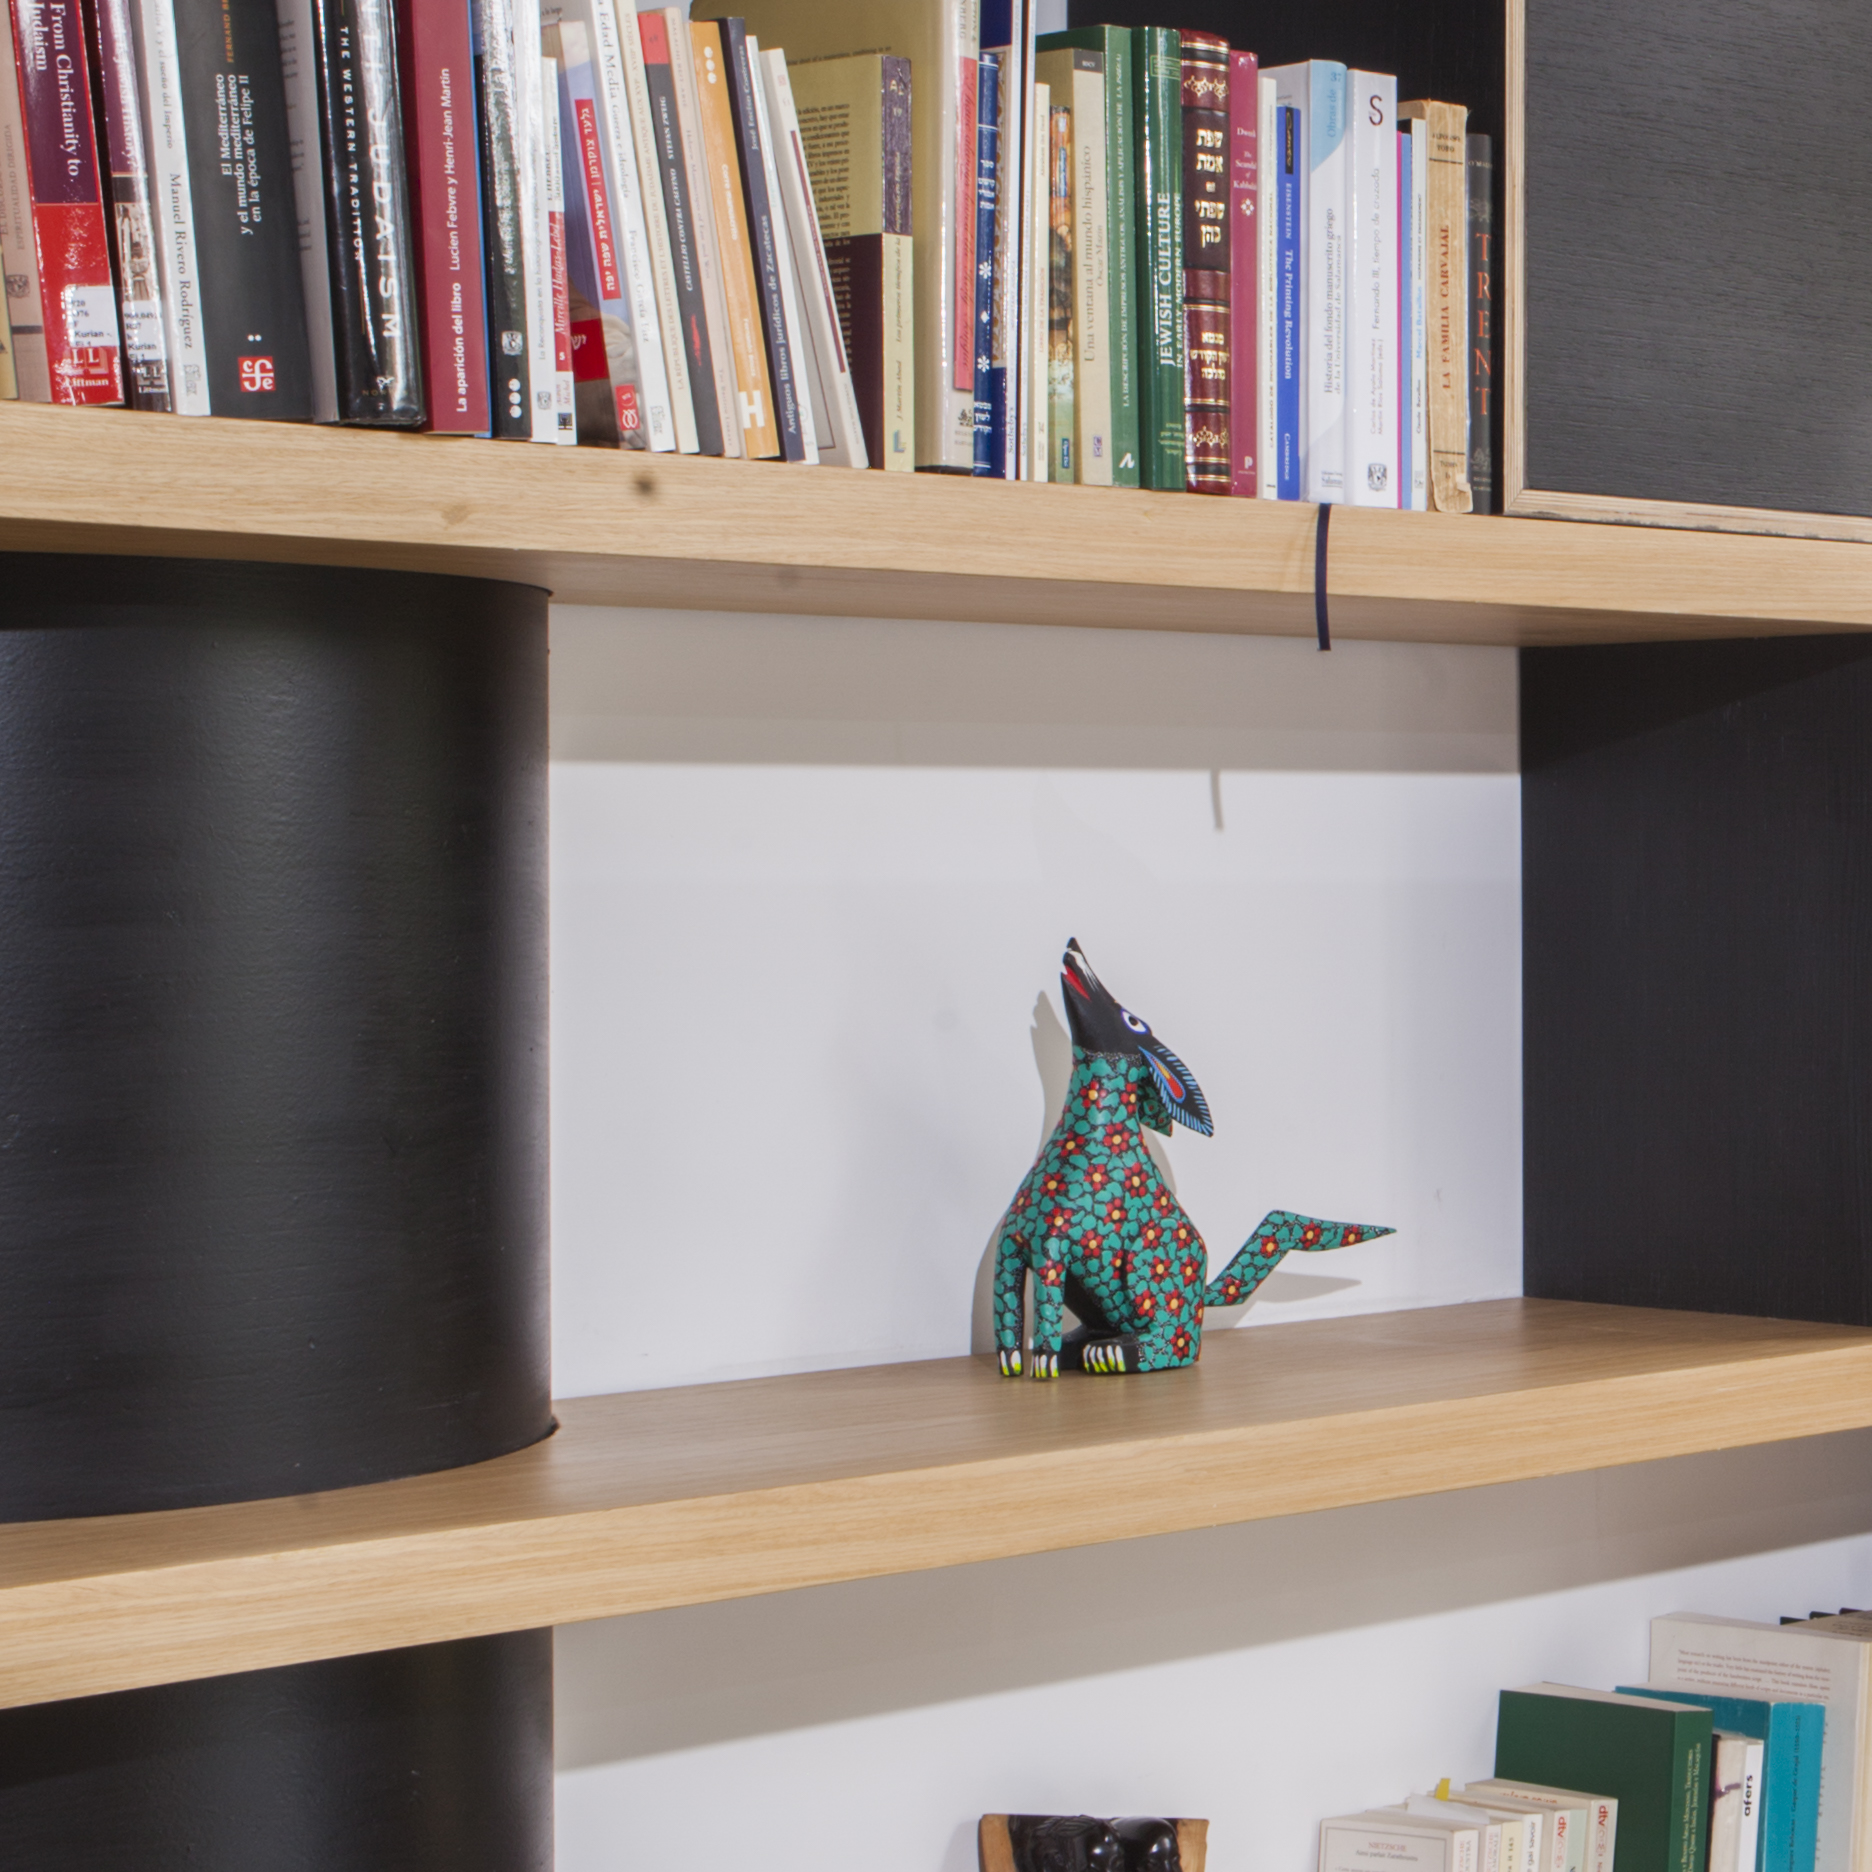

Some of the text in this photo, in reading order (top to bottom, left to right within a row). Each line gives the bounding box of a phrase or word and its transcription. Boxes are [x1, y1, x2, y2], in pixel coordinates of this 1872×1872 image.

[28, 2, 49, 71] Judaism
[50, 3, 82, 177] From Christianity to
[224, 13, 234, 64] FERNANDO
[599, 13, 614, 48] Edad
[604, 53, 620, 99] Media
[215, 73, 232, 176] El Mediterráneo
[227, 73, 253, 235] y el mundo mediterráneo
[238, 74, 262, 222] en la época de Felipe II
[339, 26, 364, 261] THE WESTERN TRADITION
[580, 107, 615, 291] גלעד צוקרמן ישראלית שפה יפה
[658, 95, 674, 159] STEFAN ZWEIG
[169, 173, 194, 349] Manuel Rivero Rodríguez
[440, 67, 469, 413] La aparición del libro Lucien Febvre y Henri-Jean Martín
[669, 167, 694, 290] CASTELLIO CONTRA CALVINO
[1079, 145, 1095, 361] Una ventana al mundo hispánico
[1155, 191, 1175, 366] JEWISH CULTURE
[1173, 192, 1184, 368] IN EARLY MODERN EUROPE
[1323, 207, 1335, 393] Historia del fondo manuscrito griego
[1438, 224, 1451, 389] LA FAMILIA CARVAJAL
[761, 215, 796, 434] Antiguos libros jurídicos de Zacatecas
[1283, 250, 1293, 379] The Printing Revolution
[1474, 232, 1492, 416] TRENT
[1525, 1851, 1535, 1865] gai
[1526, 1821, 1536, 1849] savoir
[1743, 1774, 1754, 1818] afers
